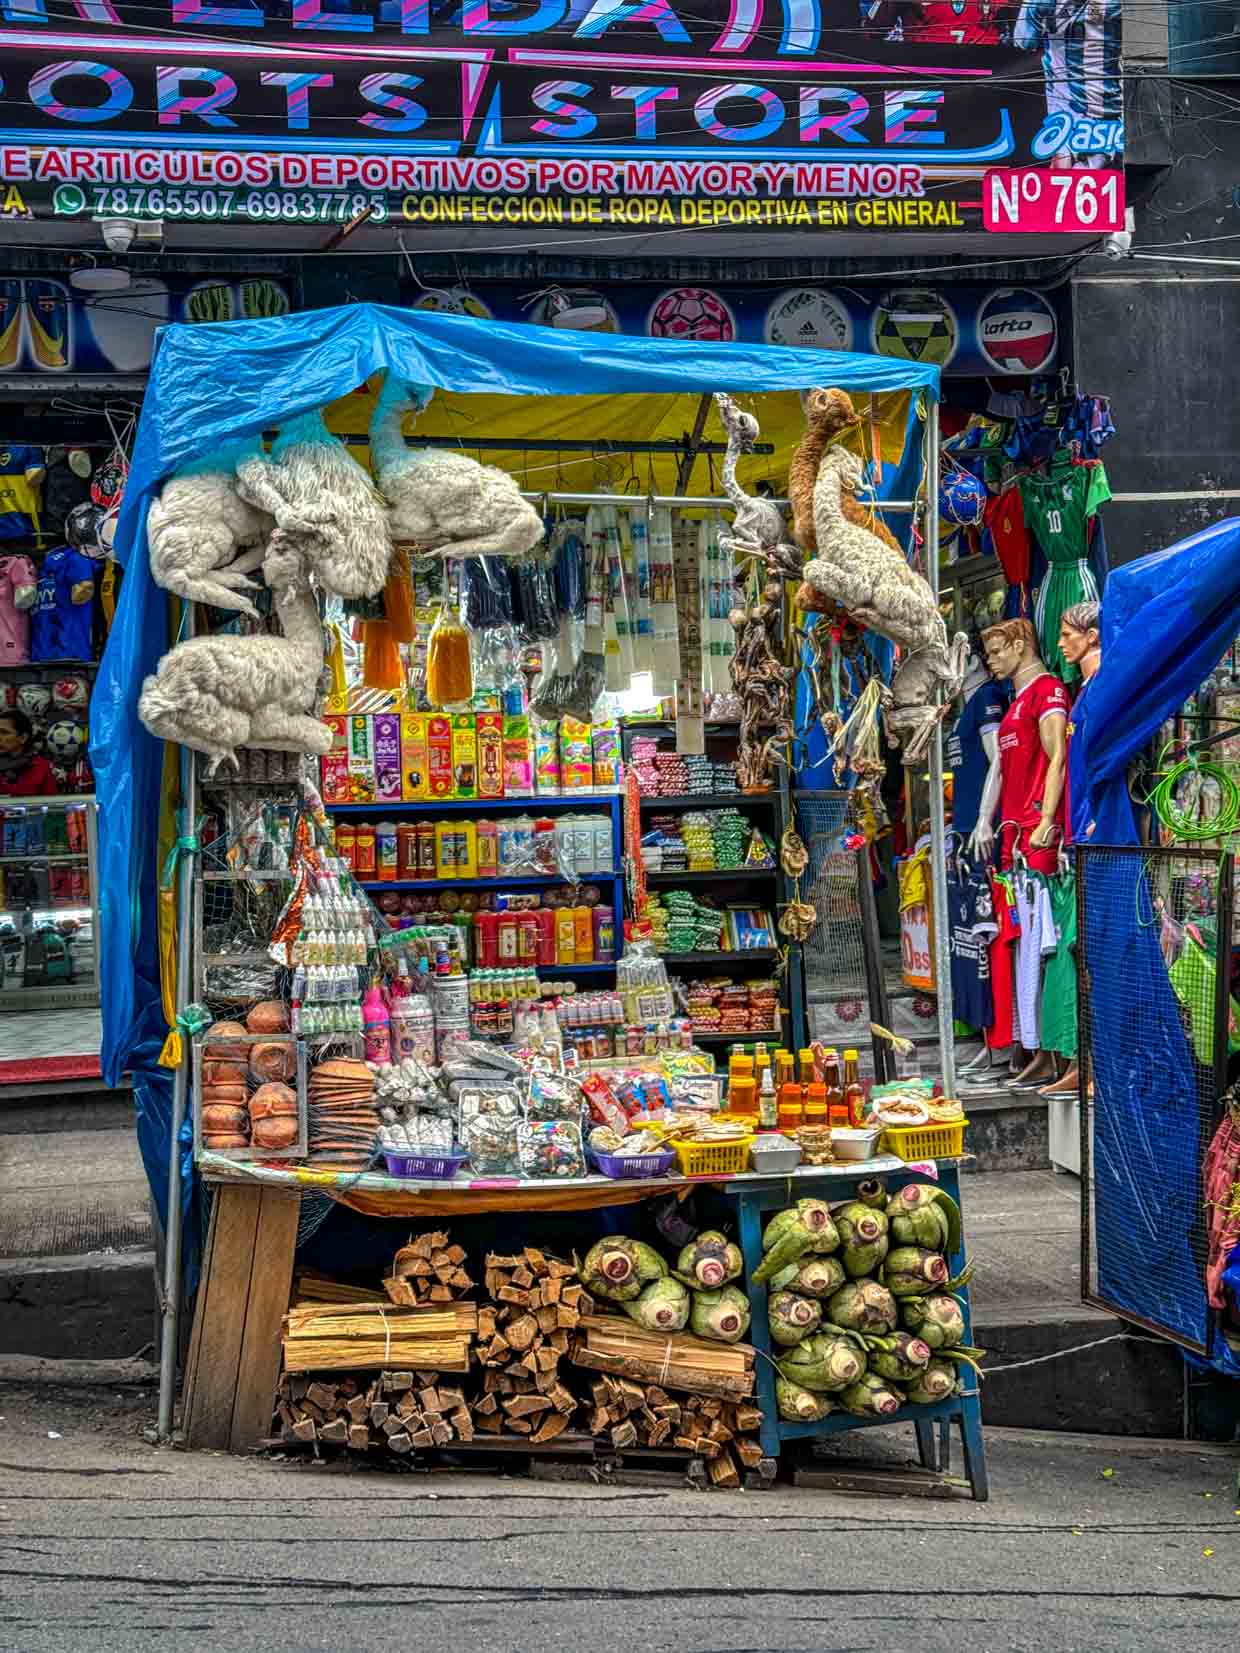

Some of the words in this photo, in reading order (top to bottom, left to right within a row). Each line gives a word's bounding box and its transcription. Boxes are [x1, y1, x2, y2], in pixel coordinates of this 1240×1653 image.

[0, 60, 428, 132] ORTS
[530, 80, 945, 144] STORE
[40, 151, 271, 185] ARTICULOS
[281, 156, 528, 190] DEPORTIVOS
[538, 162, 616, 191] POR
[626, 164, 754, 193] MAYOR
[762, 165, 789, 193] Y
[799, 166, 924, 194] MENOR
[92, 187, 386, 221] 78765507-69837785
[402, 195, 563, 223] CONFECCION
[570, 197, 602, 224] DE
[609, 199, 676, 225] ROPA
[680, 199, 810, 226] DEPORTIVA
[817, 202, 848, 226] EN
[855, 201, 965, 227] GENERAL
[1050, 174, 1118, 225] 761
[983, 319, 1033, 336] lotto
[1046, 509, 1062, 534] 10
